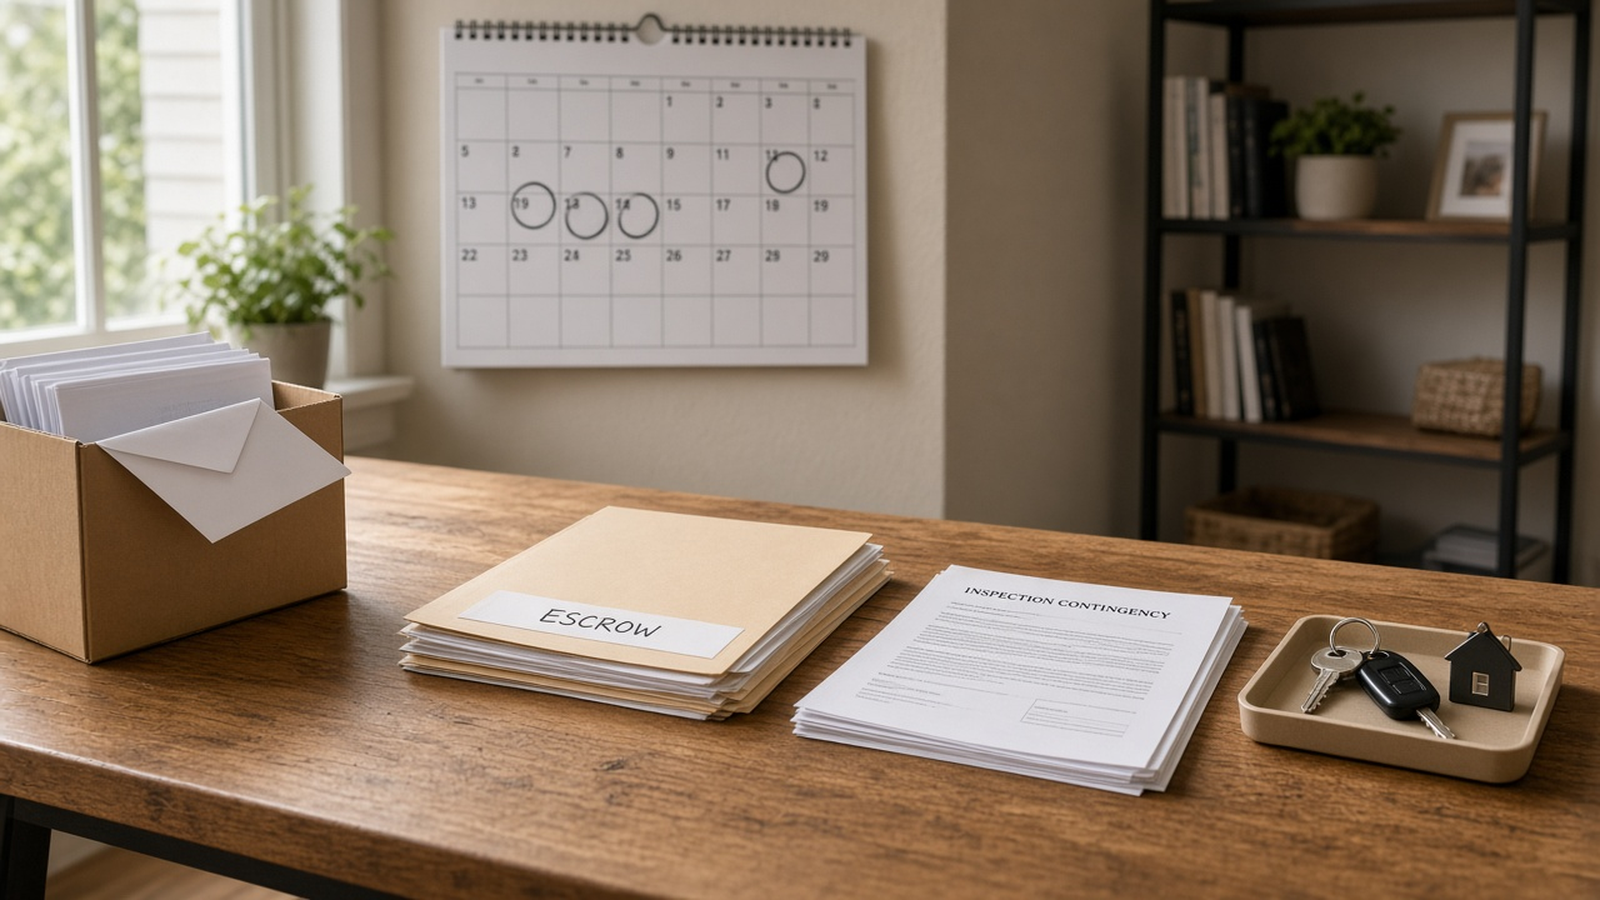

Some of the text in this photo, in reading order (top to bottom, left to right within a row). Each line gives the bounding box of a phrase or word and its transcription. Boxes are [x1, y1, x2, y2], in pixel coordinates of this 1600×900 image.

[665, 95, 673, 108] 1
[715, 95, 724, 109] 2
[460, 144, 470, 158] 5
[563, 145, 572, 159] 7
[665, 147, 675, 160] 9
[715, 148, 730, 161] 11
[813, 149, 829, 163] 12
[461, 196, 477, 210] 13
[666, 198, 682, 212] 15
[715, 198, 732, 212] 17
[765, 198, 781, 213] 18
[813, 199, 829, 213] 19
[461, 248, 830, 263] 22 23 24 25 26 27 28 29
[964, 586, 1054, 606] INSPECTION
[1057, 599, 1171, 620] CONTINGENCY
[539, 608, 662, 638] ESCROW
